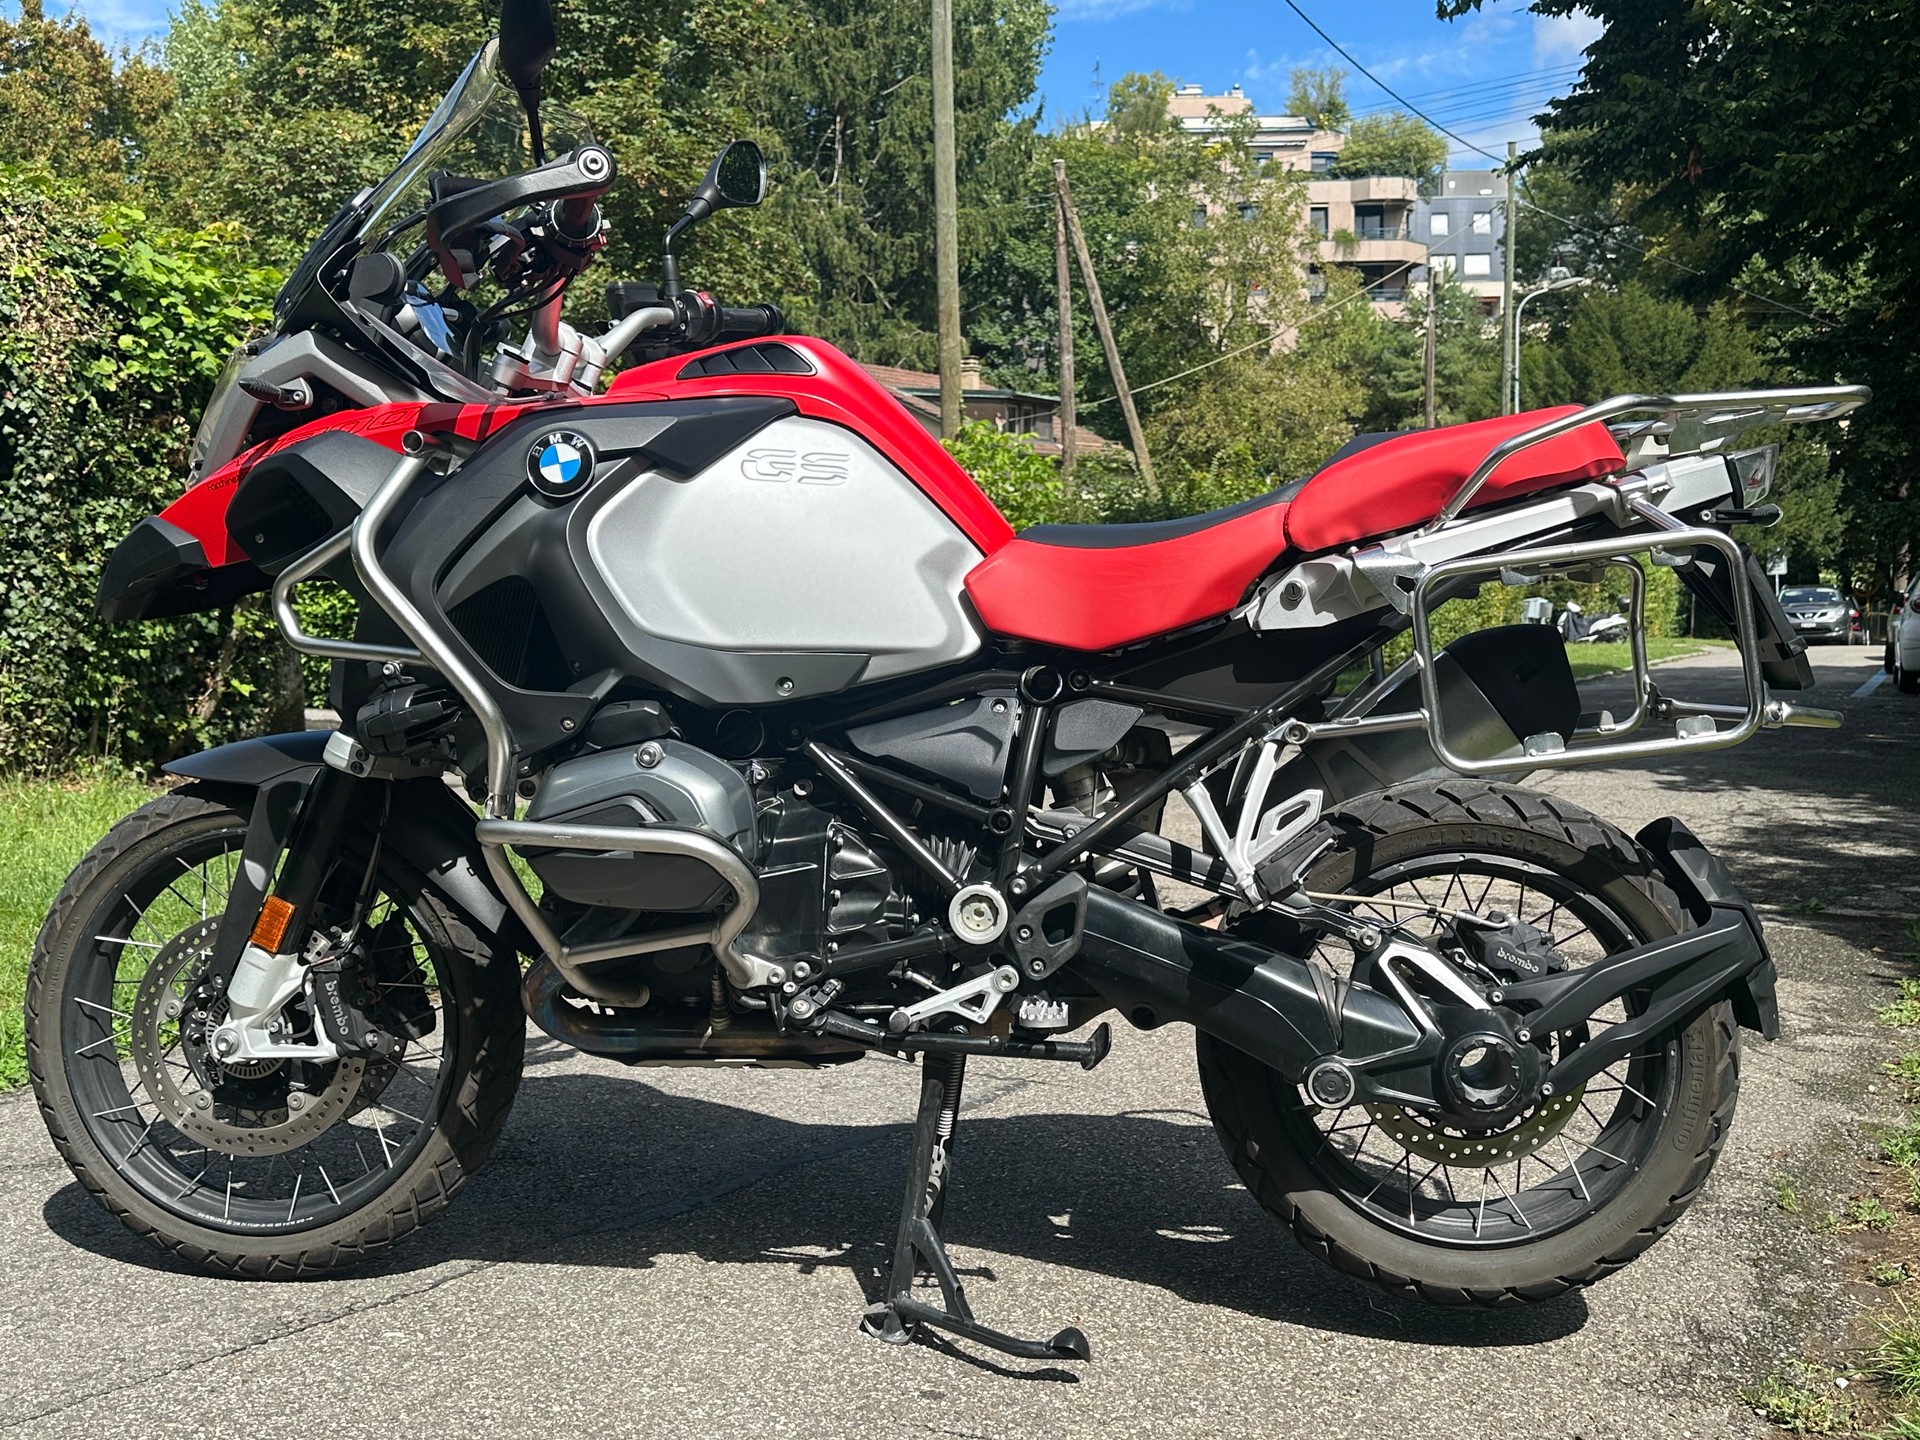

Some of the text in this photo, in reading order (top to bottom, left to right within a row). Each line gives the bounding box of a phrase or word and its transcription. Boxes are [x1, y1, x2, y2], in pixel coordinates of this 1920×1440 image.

[531, 433, 586, 459] BMW
[740, 448, 850, 486] GS
[1496, 946, 1540, 974] brembo
[324, 979, 349, 1036] brembo
[1671, 1044, 1706, 1152] Continental
